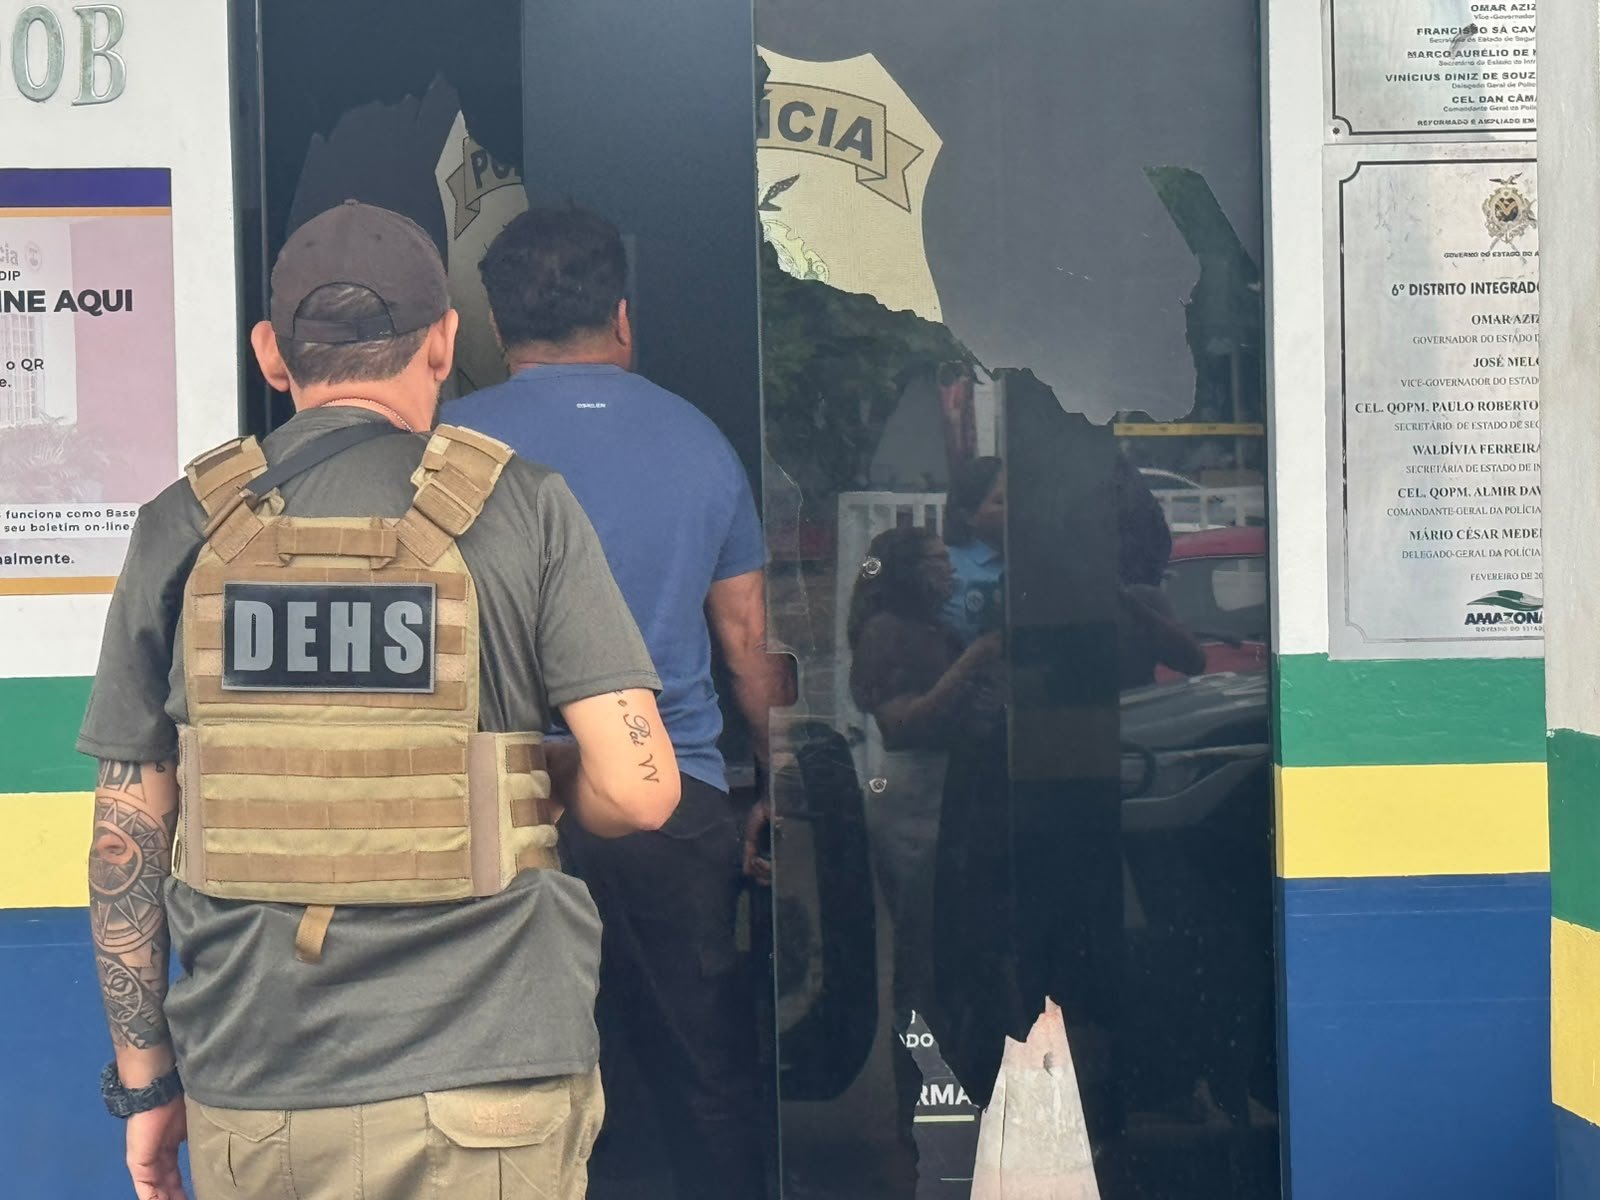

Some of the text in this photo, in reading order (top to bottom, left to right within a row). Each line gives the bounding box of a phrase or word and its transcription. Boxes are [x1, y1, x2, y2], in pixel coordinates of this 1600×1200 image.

[1471, 4, 1506, 12] OMAR
[12, 4, 126, 106] OB
[1455, 48, 1509, 58] AURÉLIO
[1385, 72, 1441, 82] VINÍCIUS
[1482, 72, 1498, 80] DE
[1502, 72, 1536, 80] SOUZ
[1452, 96, 1475, 104] CEL
[1479, 95, 1504, 103] DAN
[1409, 282, 1466, 296] DISTRITO
[0, 289, 133, 316] NE AQUI
[1471, 314, 1511, 325] OMAR
[1412, 335, 1478, 345] GOVERNADOR
[1481, 335, 1494, 344] DO
[1496, 334, 1532, 344] ESTADO
[6, 358, 45, 371] o QR
[1473, 354, 1504, 368] JOSÉ
[1401, 376, 1539, 388] VICE-GOVERNADOR DO ESTAD
[1355, 400, 1539, 415] CEL. QOPM. PAULO ROBERTO
[1394, 420, 1452, 431] SECRETÁRIO
[1457, 421, 1469, 430] DE
[1471, 421, 1507, 430] ESTADO
[1509, 420, 1522, 429] DE
[1412, 441, 1477, 456] WALDÍVIA
[1406, 463, 1464, 474] SECRETÁRIA
[1465, 464, 1478, 473] DE
[1480, 463, 1516, 472] ESTADO
[1518, 463, 1531, 472] DE
[1397, 487, 1427, 498] CEL.
[1429, 487, 1472, 500] QOPM.
[1474, 486, 1517, 497] ALMIR
[6, 509, 61, 519] funciona
[66, 510, 102, 518] como
[106, 509, 137, 518] Base
[1387, 504, 1541, 517] COMANDANTE-GERAL DA POLÍCIA
[4, 524, 26, 533] seu
[30, 522, 80, 532] boletim
[1409, 527, 1454, 541] MÁRIO
[1456, 527, 1499, 540] CÉSAR
[0, 552, 75, 565] almente.
[1402, 547, 1541, 559] DELEGADO-GERAL DA POLÍCIA
[1470, 572, 1519, 581] FEVEREIRO
[1520, 572, 1533, 580] DE
[233, 600, 424, 674] DEHS
[899, 1033, 934, 1048] DO
